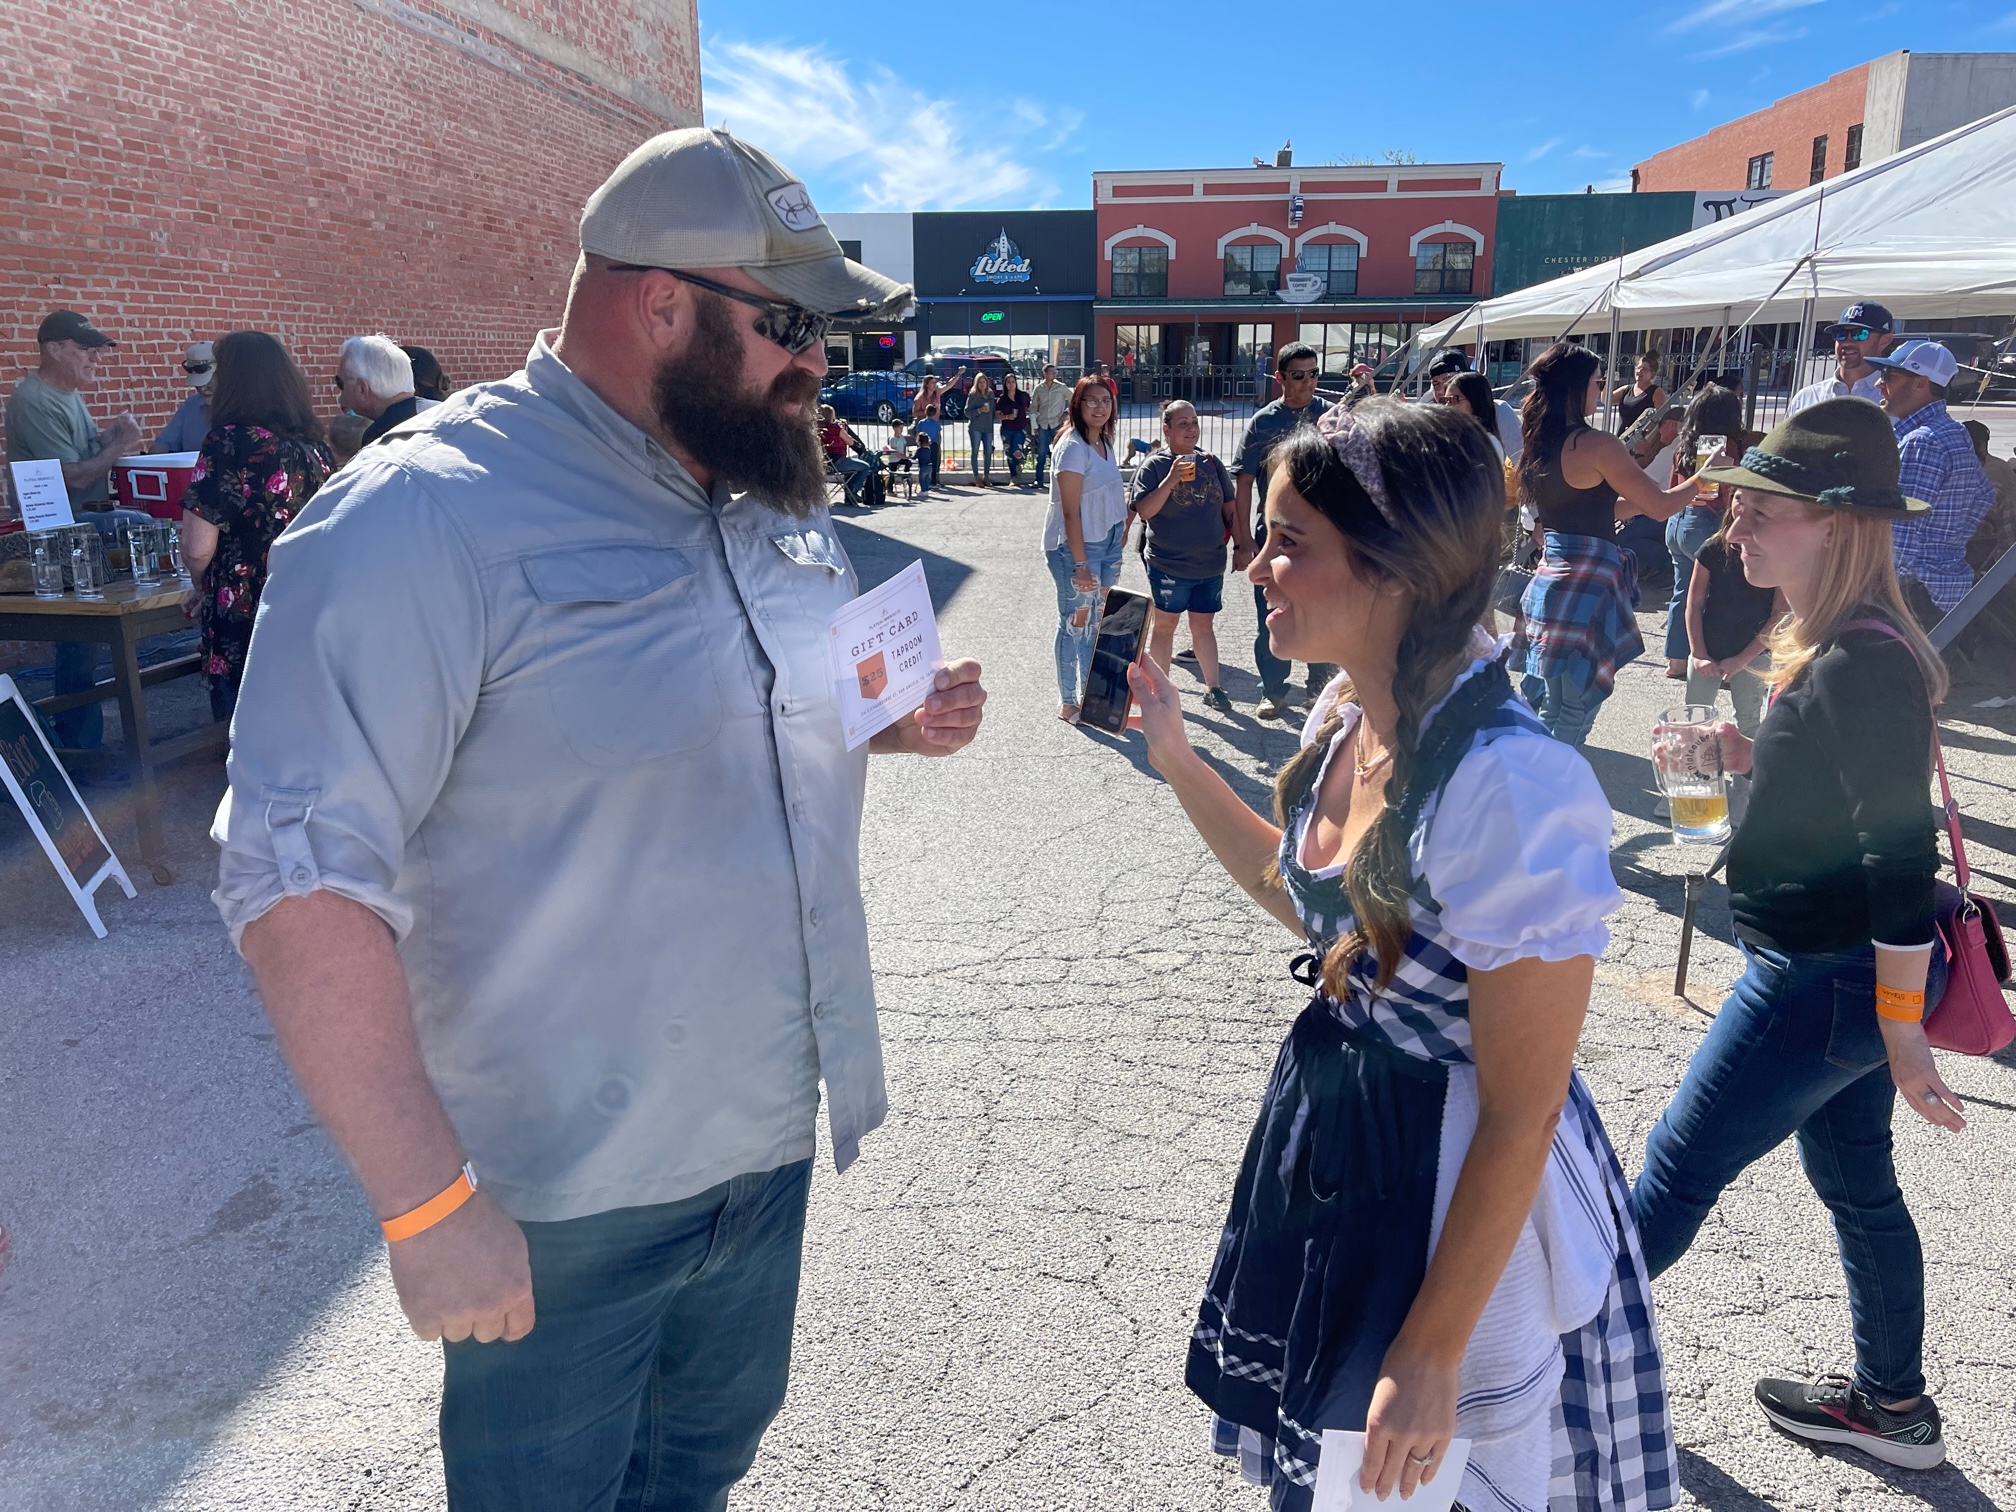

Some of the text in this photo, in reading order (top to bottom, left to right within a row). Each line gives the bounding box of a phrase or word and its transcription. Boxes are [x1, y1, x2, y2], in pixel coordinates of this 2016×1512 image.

[974, 256, 1032, 276] Lifted
[1544, 256, 1588, 264] CHESTER
[982, 312, 1003, 321] OPEN
[879, 336, 894, 347] OPEN
[851, 632, 885, 657] GIFT
[889, 610, 919, 636] CARD
[891, 633, 924, 661] TAPROOM
[899, 651, 924, 673] CREDIT
[861, 667, 885, 688] $25
